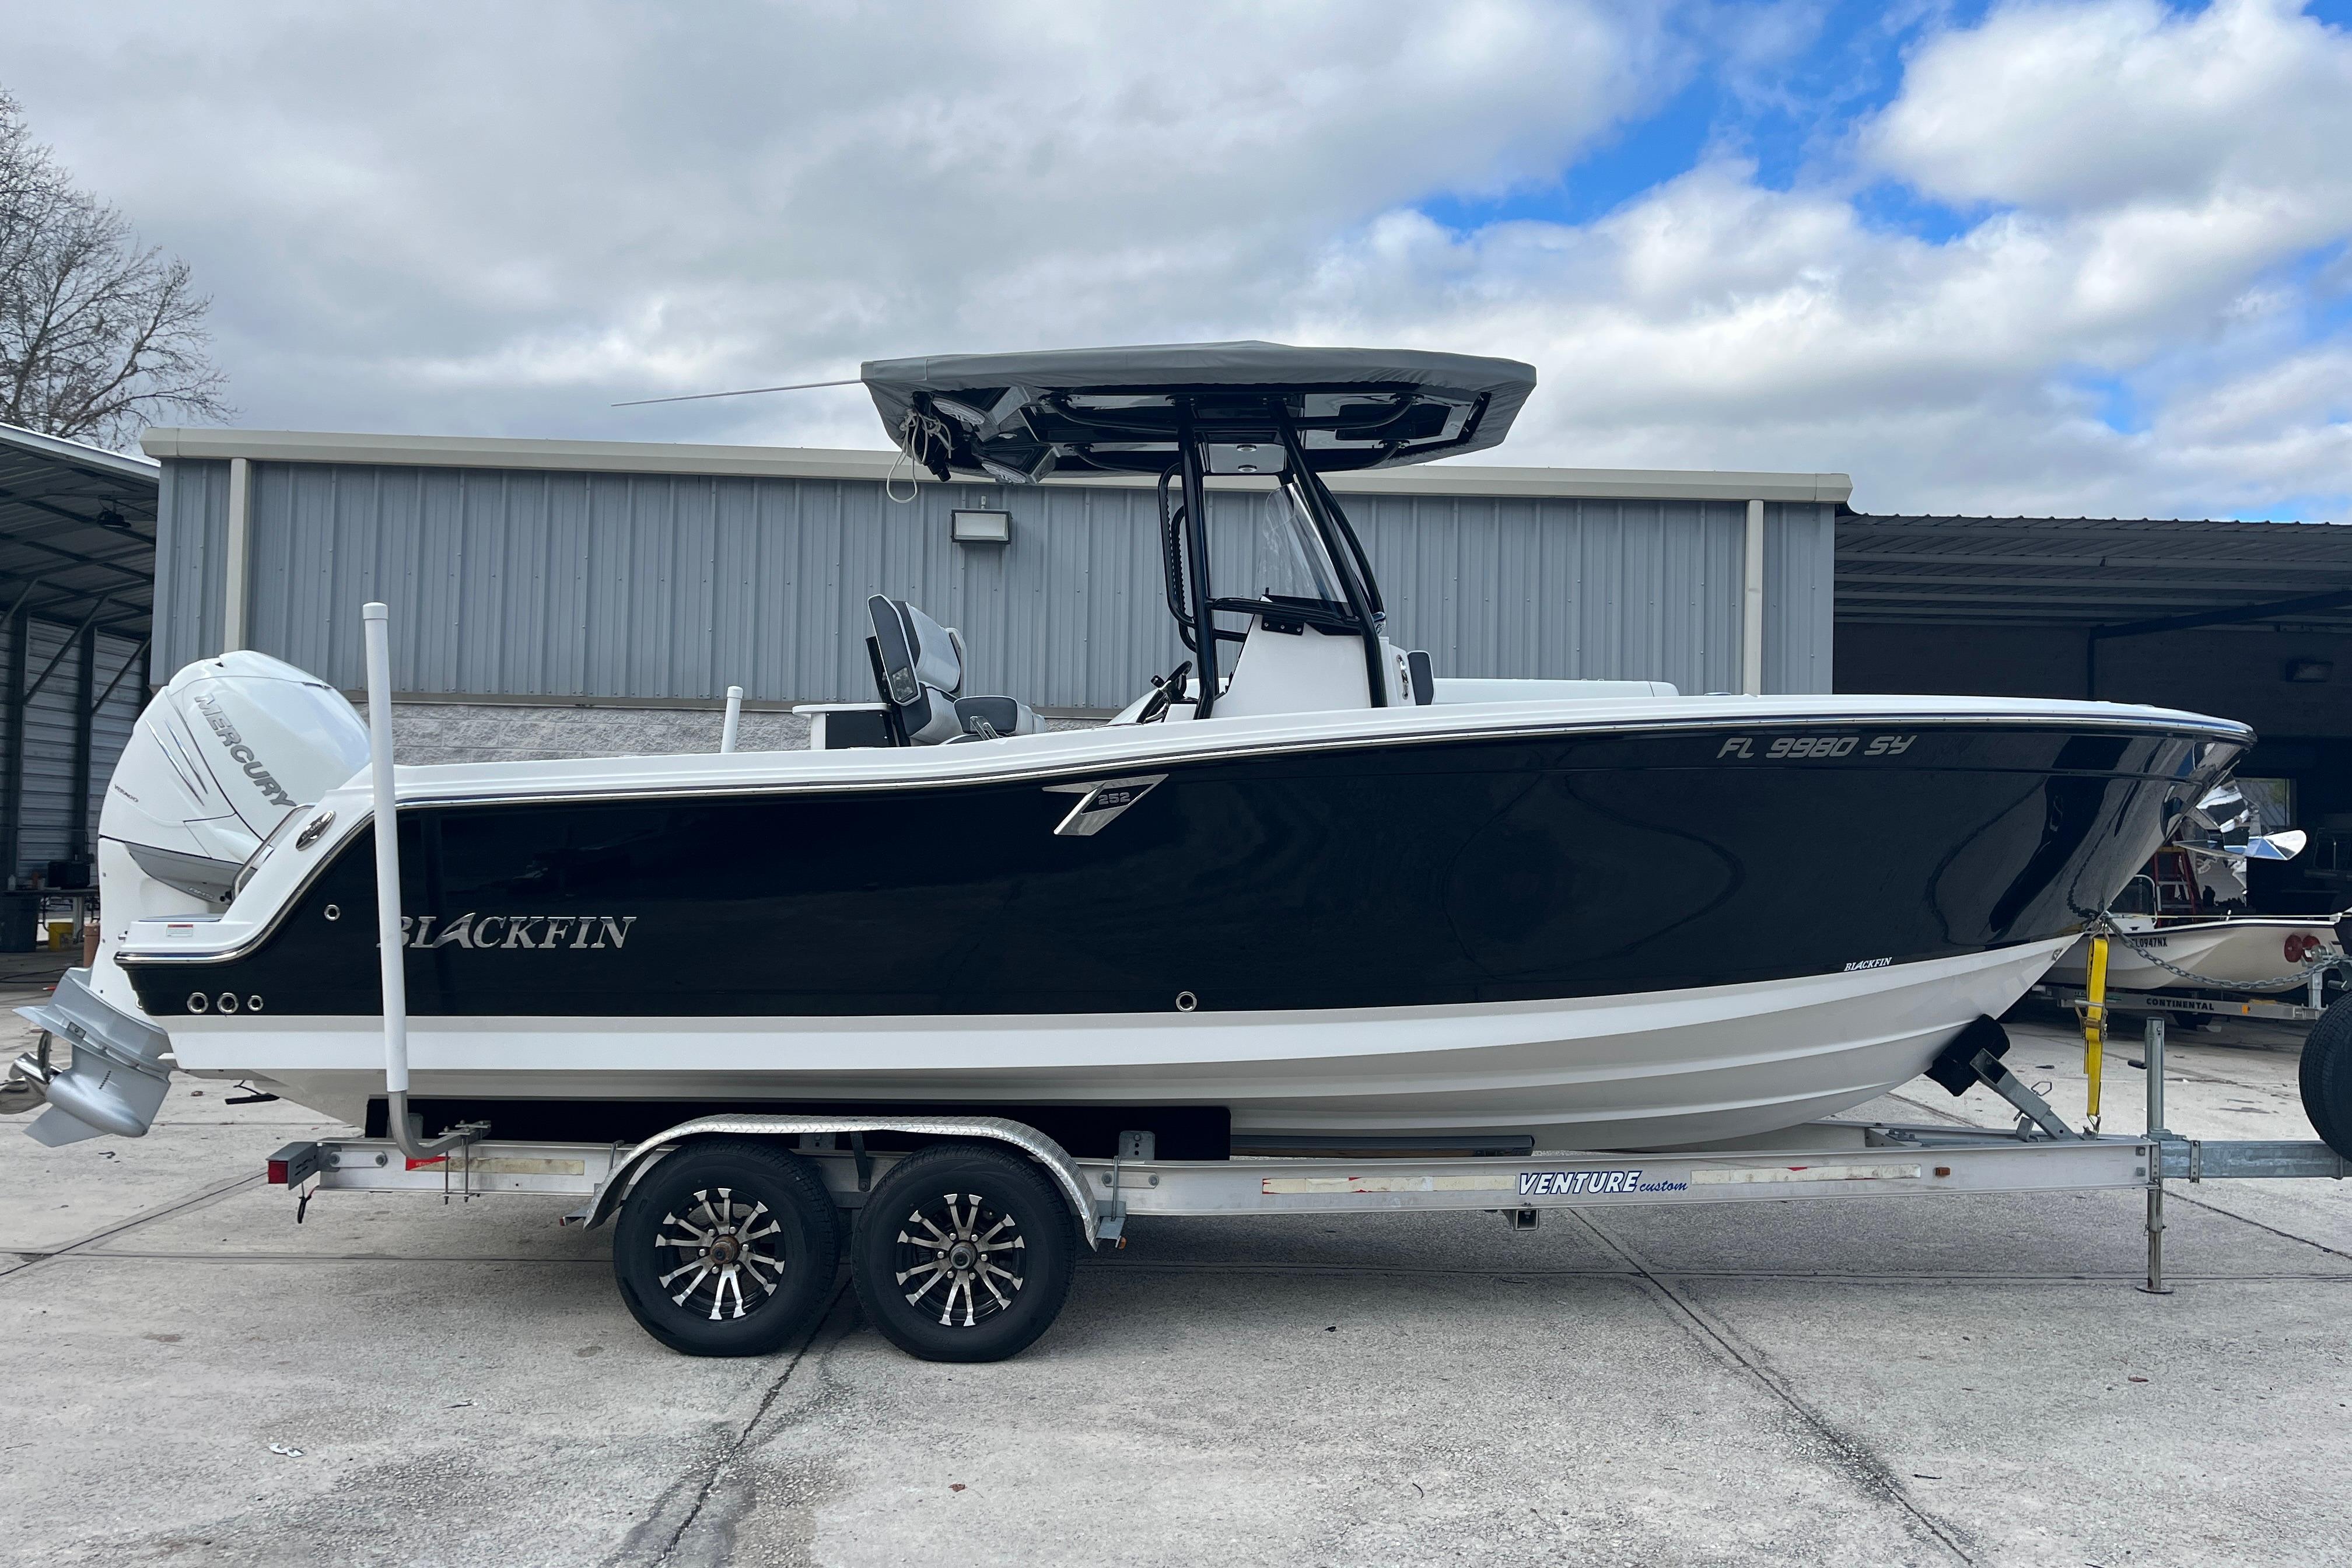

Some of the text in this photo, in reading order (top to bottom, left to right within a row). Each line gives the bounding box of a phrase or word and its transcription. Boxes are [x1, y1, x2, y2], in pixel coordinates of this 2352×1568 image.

[194, 692, 297, 807] MERCURY
[1716, 734, 1918, 759] FL 9980 SY
[1098, 792, 1131, 805] 252
[2130, 937, 2168, 948] L0947NX
[1843, 957, 1893, 972] BLACKFIN
[2146, 998, 2215, 1011] CONTINENTAL
[1519, 1170, 1689, 1195] VENTURE custom
